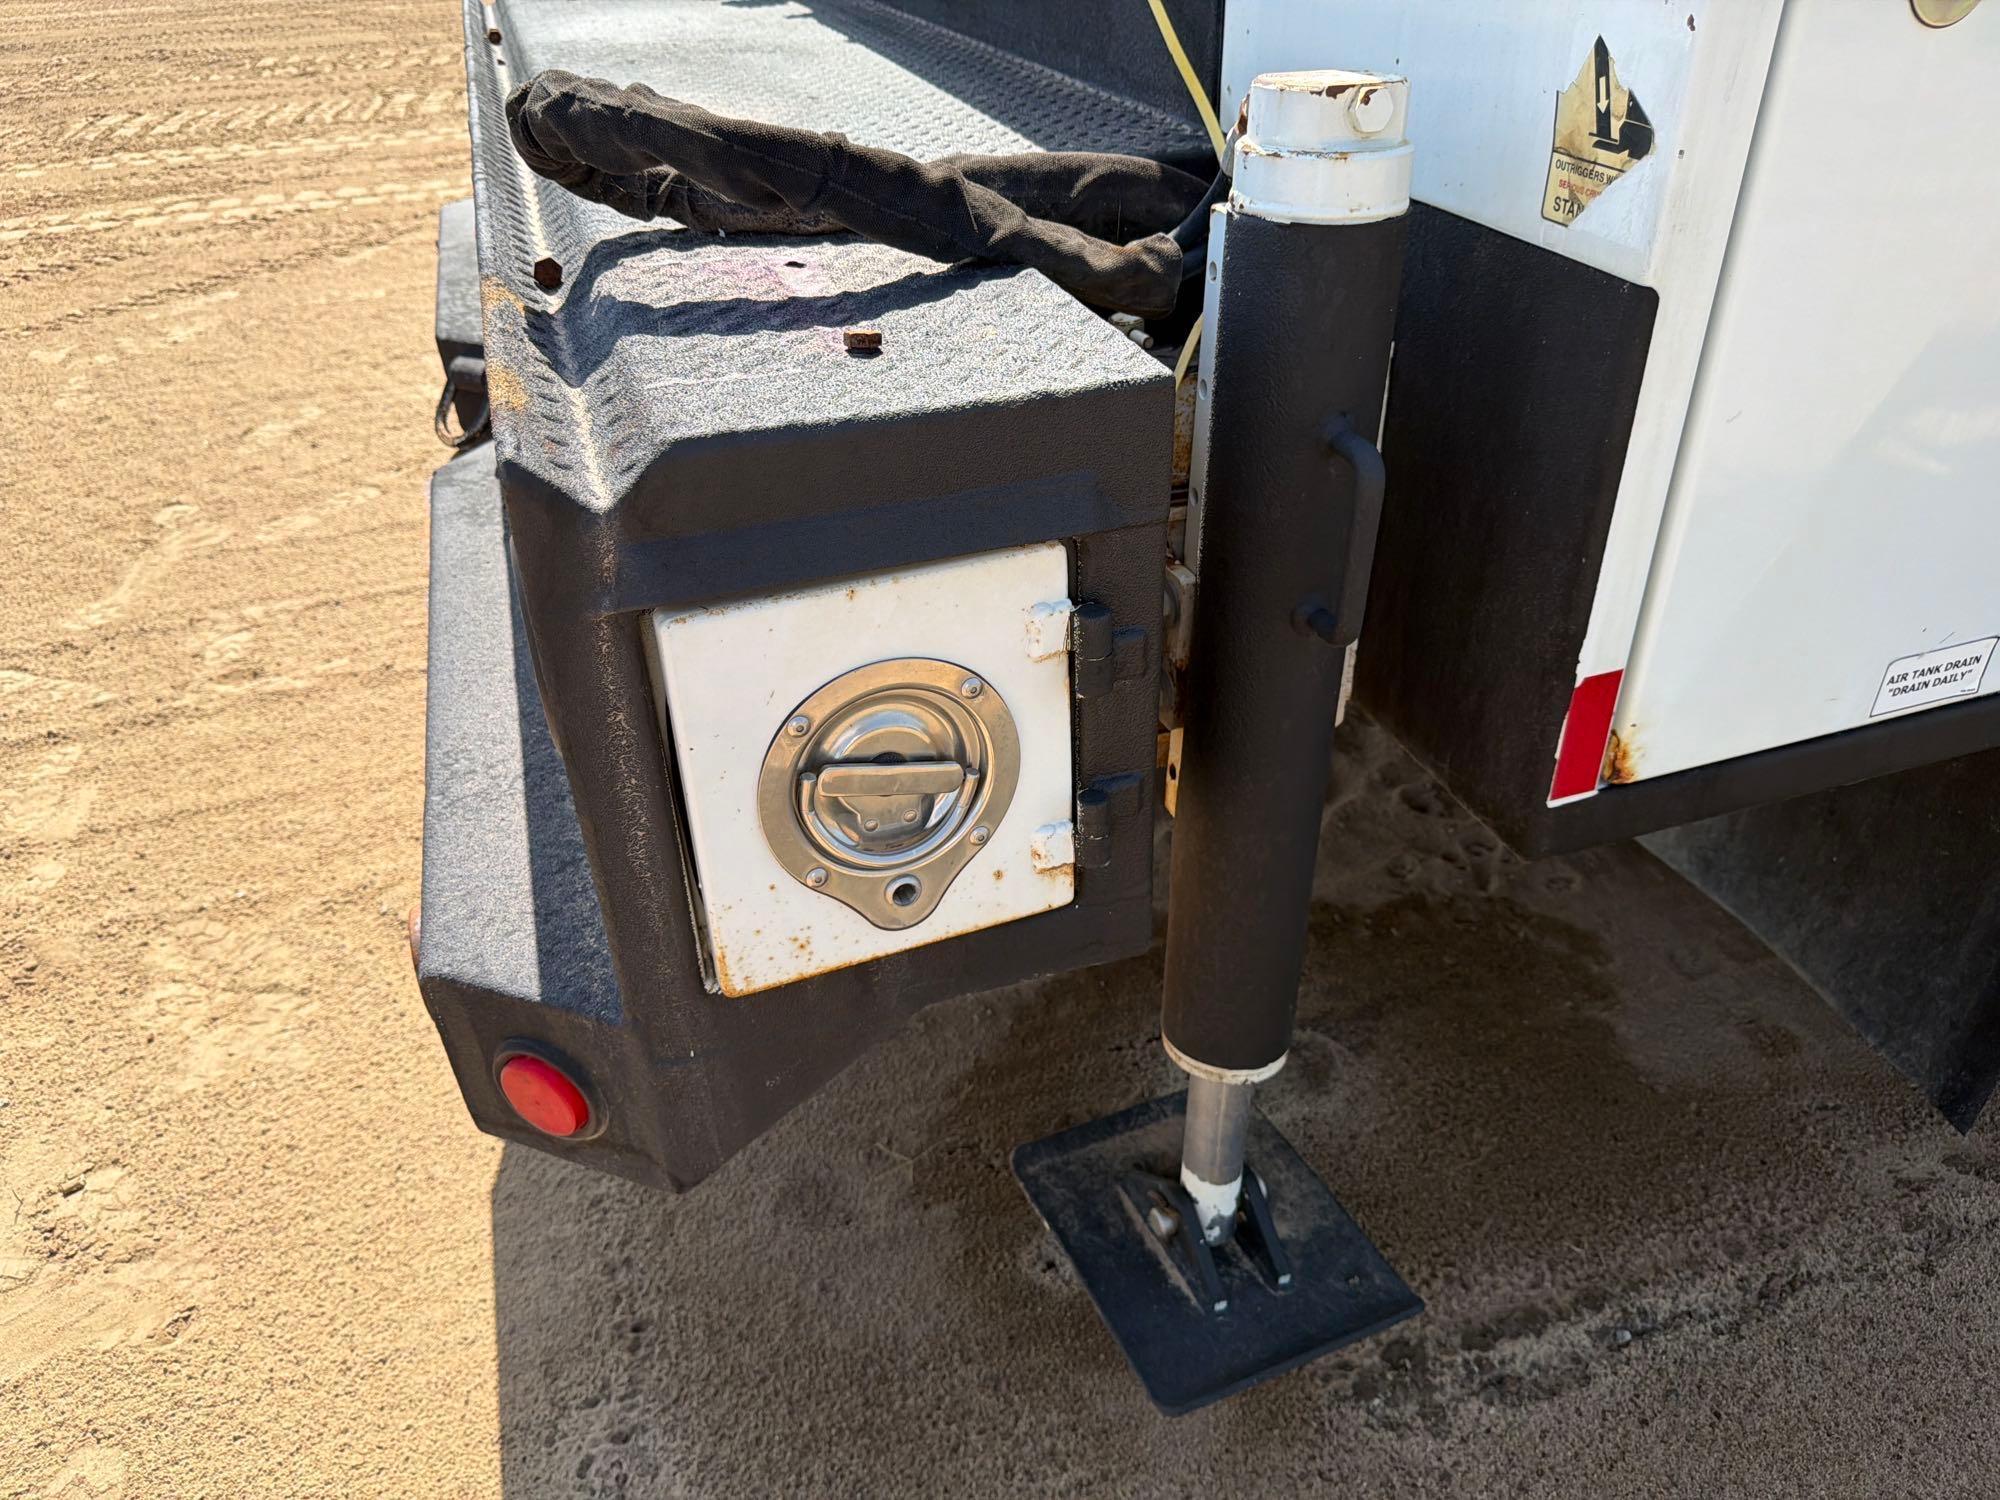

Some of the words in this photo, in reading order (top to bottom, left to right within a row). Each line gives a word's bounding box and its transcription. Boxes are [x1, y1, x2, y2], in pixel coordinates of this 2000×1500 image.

[1555, 159, 1605, 182] OUTRIGGERS
[1887, 672, 1908, 685] AIR
[1912, 664, 1943, 679] TANK
[1944, 654, 1982, 671] DRAIN
[1888, 680, 1931, 696] "DRAIN
[1932, 669, 1973, 687] DAILY"
